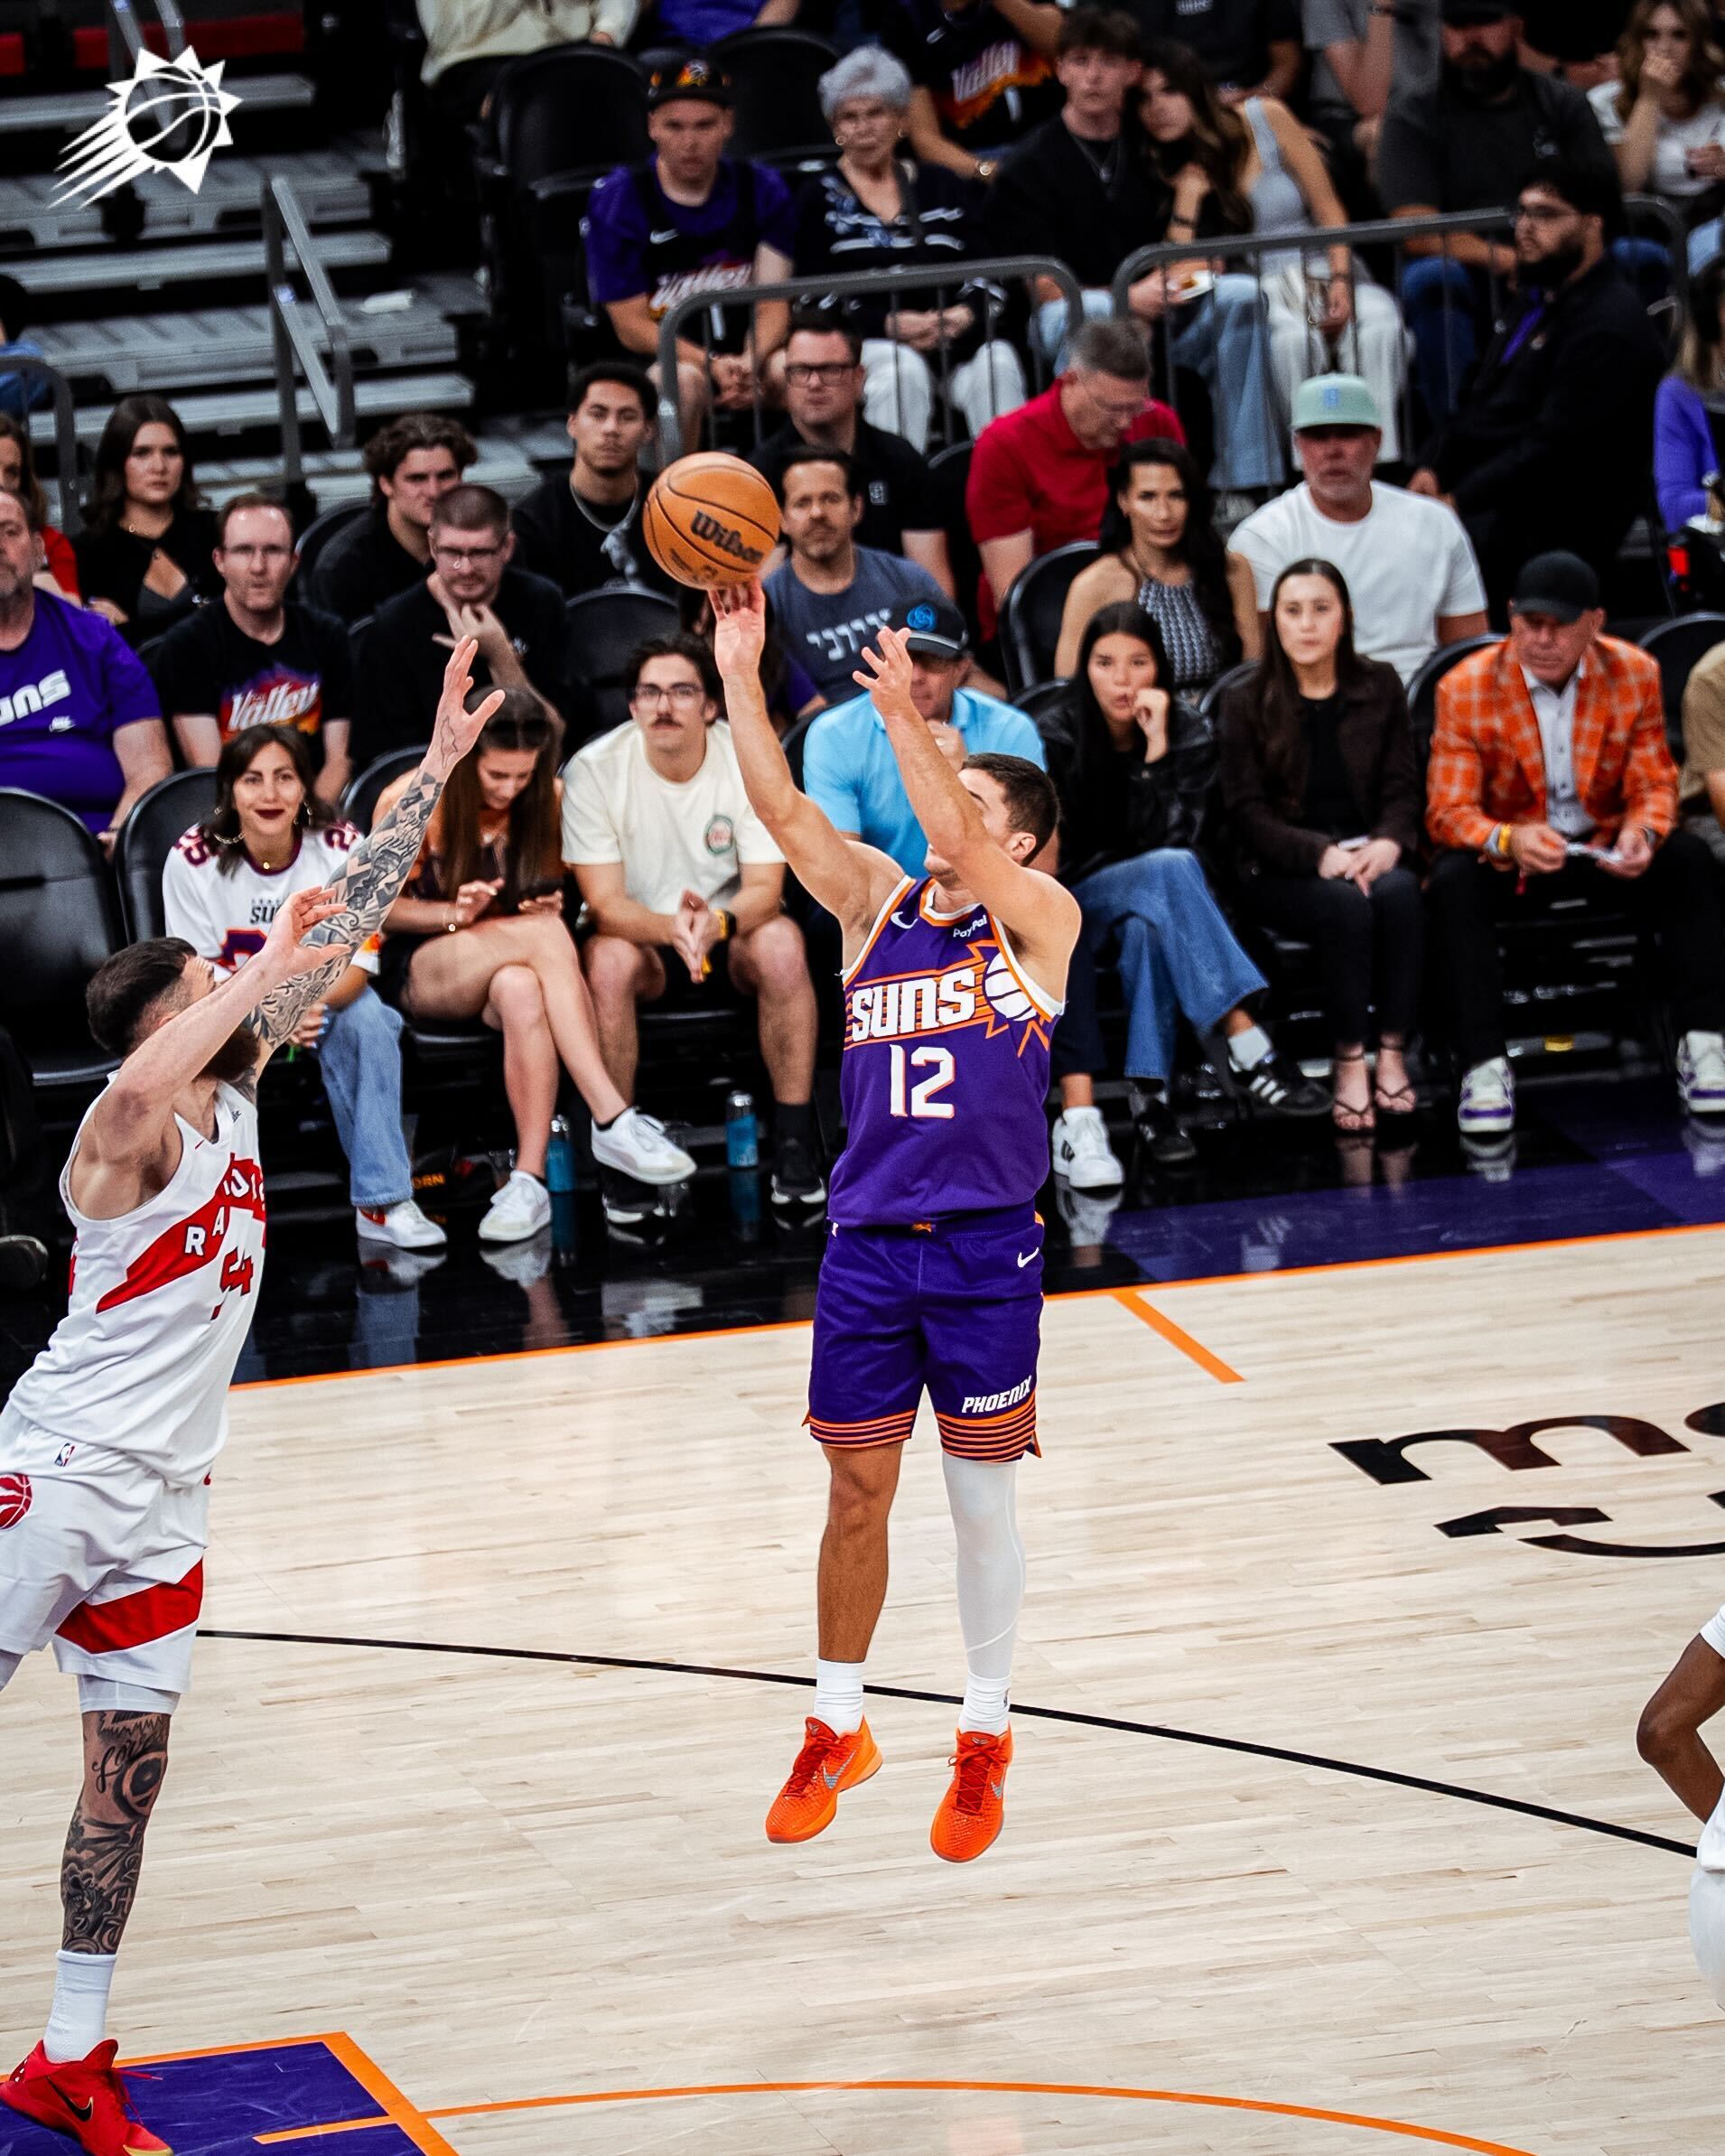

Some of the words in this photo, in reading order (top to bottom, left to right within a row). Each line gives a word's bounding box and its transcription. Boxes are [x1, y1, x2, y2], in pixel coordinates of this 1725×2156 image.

[228, 681, 319, 732] Valley
[953, 914, 987, 938] PayPal
[852, 968, 976, 1042] SUNS
[890, 1044, 956, 1119] 12
[962, 1375, 1032, 1414] PHOENIX
